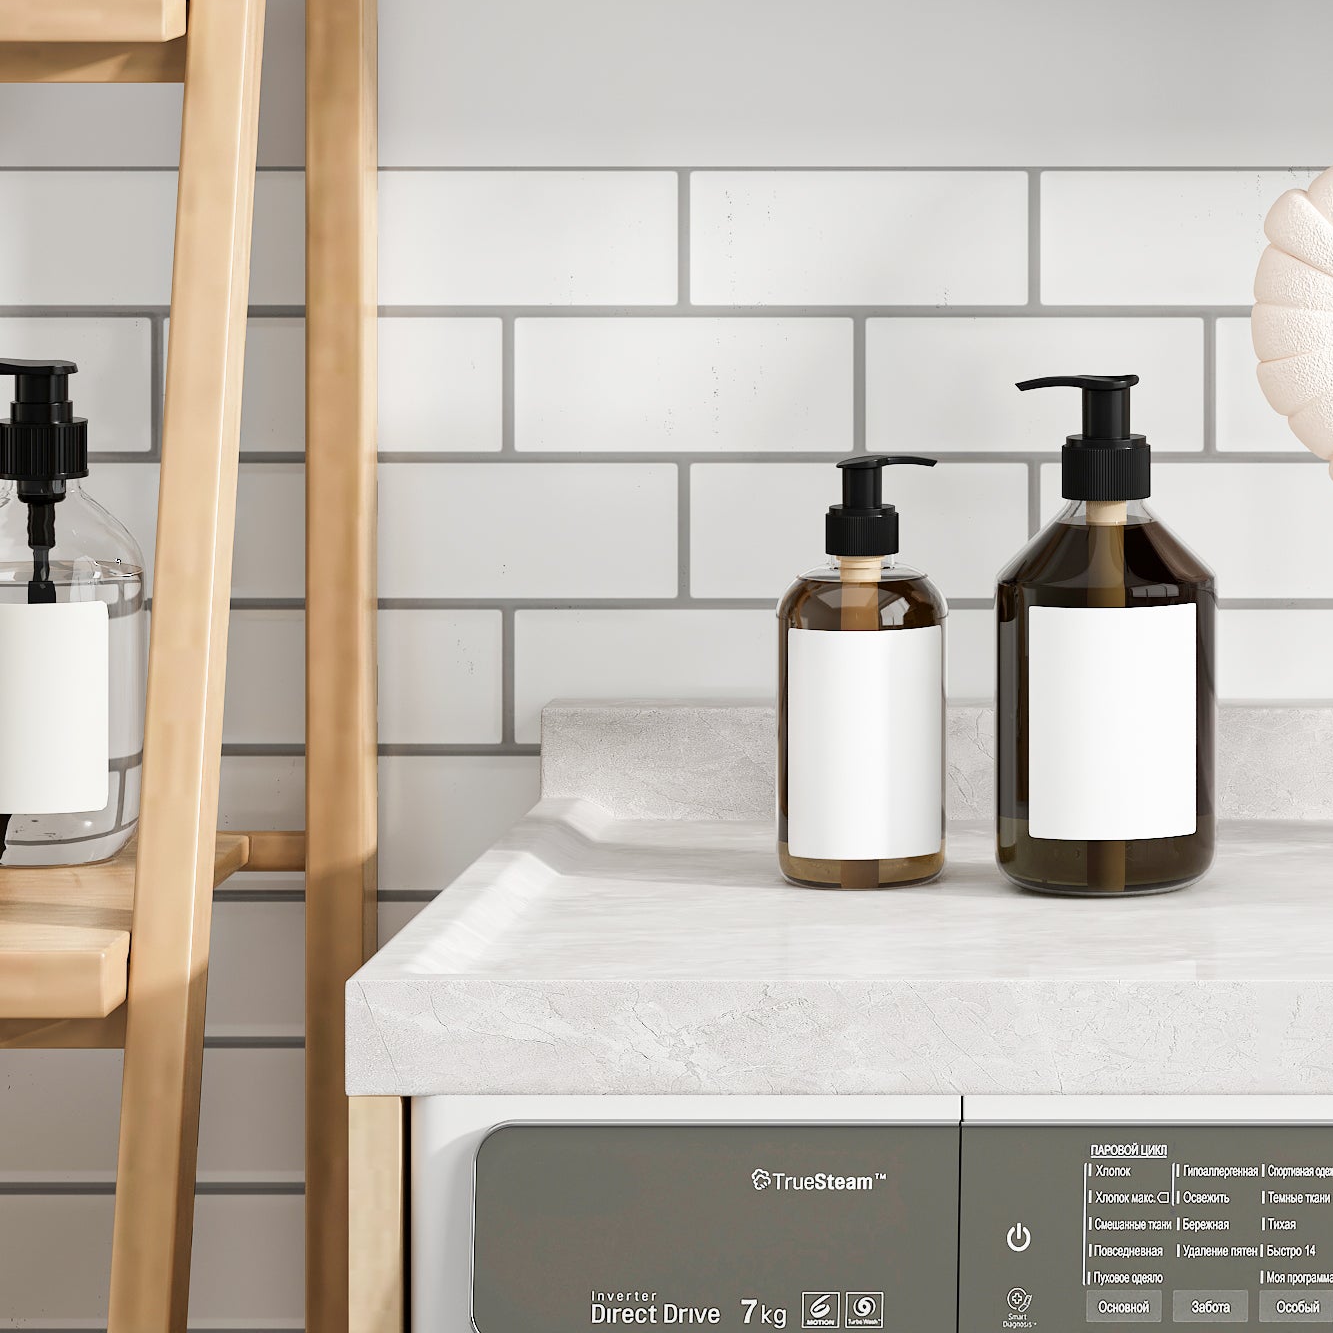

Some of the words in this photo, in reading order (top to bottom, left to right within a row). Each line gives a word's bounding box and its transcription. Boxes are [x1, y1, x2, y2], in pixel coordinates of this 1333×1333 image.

[1091, 1142, 1139, 1156] ПАРОВОЙ
[1141, 1144, 1168, 1157] ЦИКЛ
[1095, 1164, 1131, 1177] Хлопок
[1183, 1164, 1259, 1179] Гипоаллергенная
[1268, 1164, 1314, 1179] Спортивная
[1095, 1191, 1130, 1204] Хлопок
[1131, 1193, 1156, 1204] макс.
[1183, 1191, 1230, 1204] Освежить
[1268, 1191, 1303, 1204] Темные
[1305, 1193, 1331, 1204] ткани
[1094, 1217, 1146, 1230] Смешанные
[1148, 1220, 1172, 1230] ткани
[1182, 1217, 1230, 1232] Бережная
[1268, 1217, 1296, 1230] Тихая
[1094, 1244, 1163, 1258] Повседневная
[1183, 1244, 1229, 1258] Удаление
[1230, 1247, 1258, 1257] пятен
[1266, 1244, 1302, 1259] Быстро
[1304, 1245, 1316, 1257] 14
[1093, 1271, 1130, 1286] Пуховое
[1131, 1274, 1164, 1285] одеяло
[1266, 1271, 1286, 1284] Моя
[591, 1290, 657, 1302] Inverter
[591, 1303, 657, 1324] Direct
[663, 1303, 721, 1324] Drive
[740, 1298, 758, 1324] 7
[761, 1304, 787, 1329] kg
[1098, 1299, 1150, 1314] Основной
[1191, 1300, 1231, 1314] Забота
[1276, 1300, 1320, 1314] Особый
